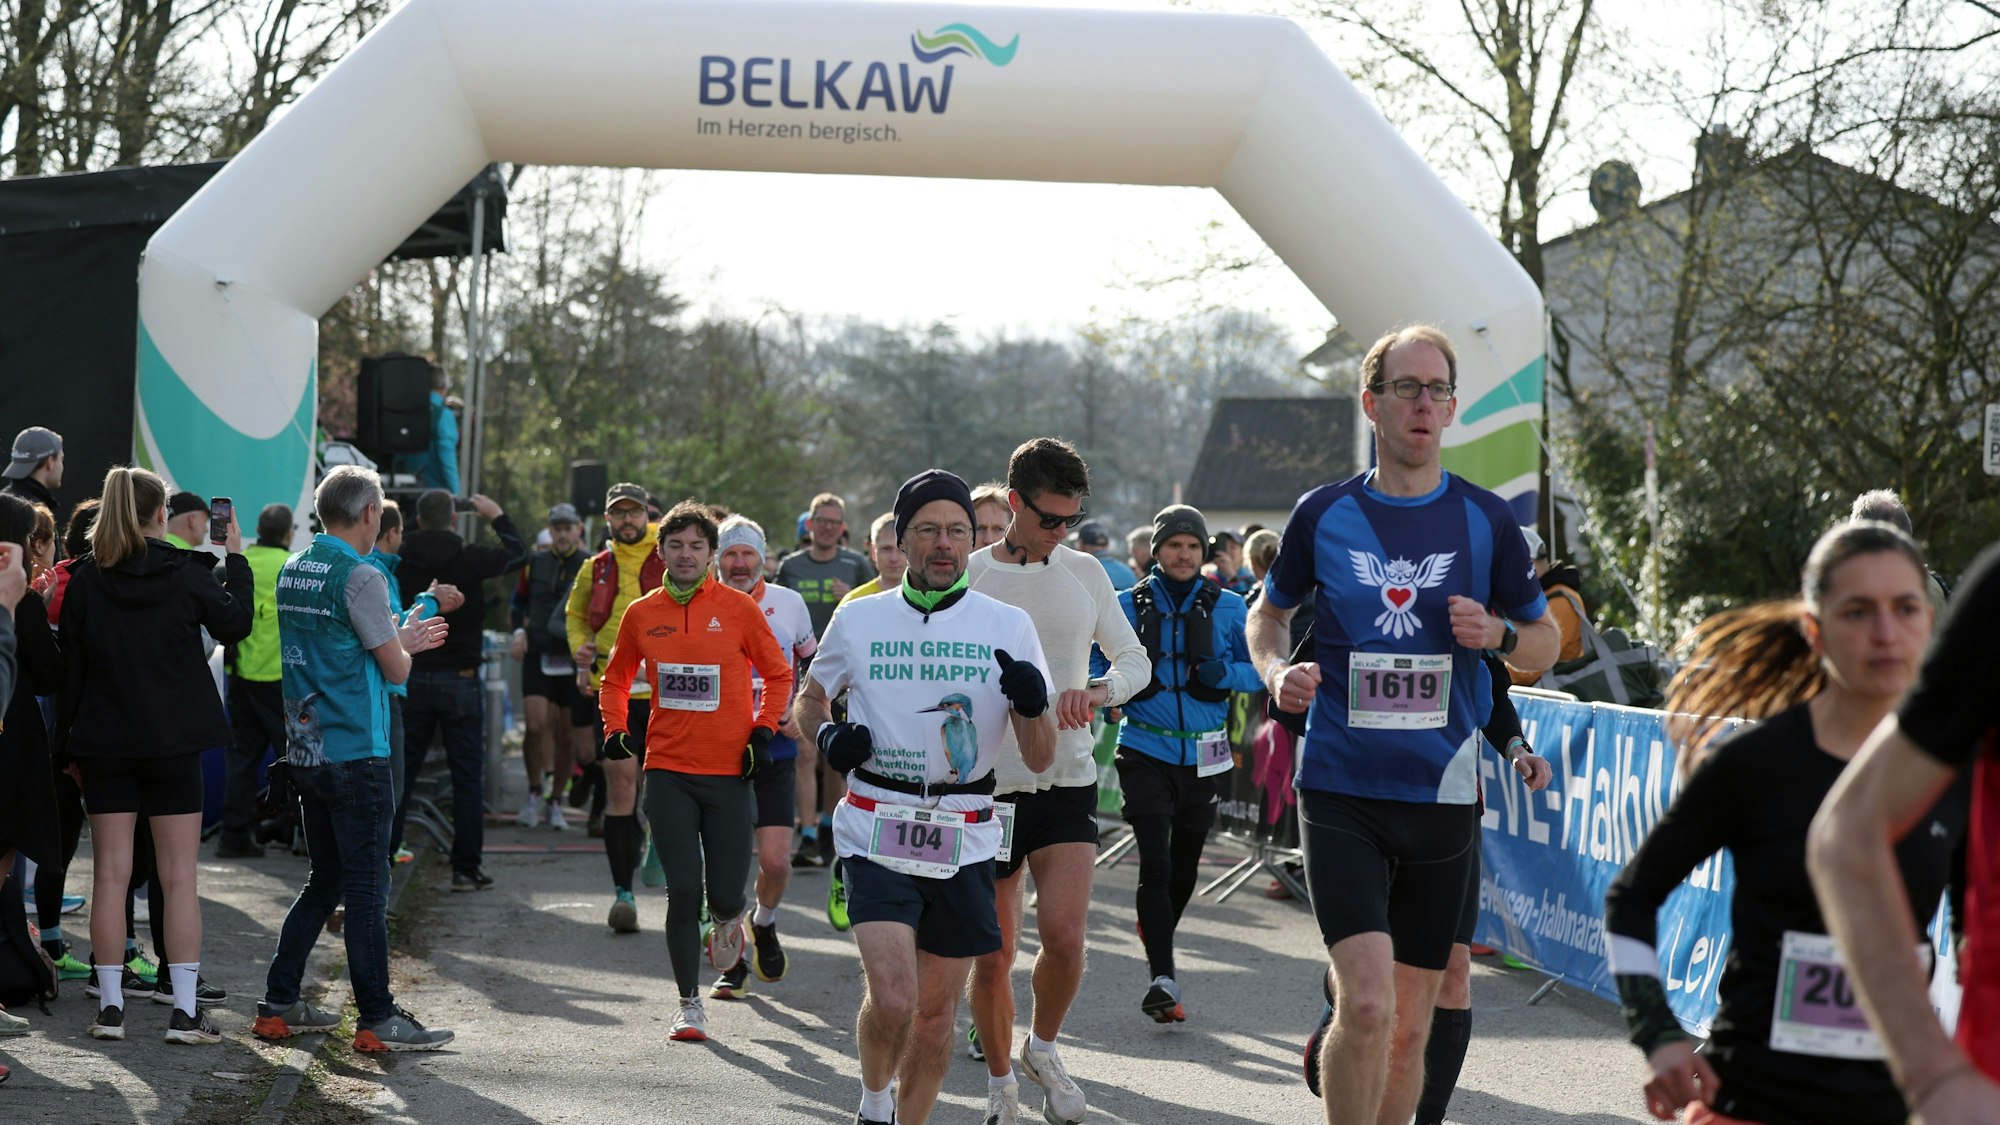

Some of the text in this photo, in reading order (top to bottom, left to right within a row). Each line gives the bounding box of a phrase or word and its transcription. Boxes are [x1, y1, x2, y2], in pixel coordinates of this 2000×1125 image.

[699, 55, 954, 114] BELKAW
[697, 117, 902, 145] Im Herzen bergisch.
[299, 560, 332, 574] GREEN
[293, 578, 326, 592] HAPPY
[870, 640, 992, 661] RUN GREEN
[666, 674, 710, 693] 2336
[869, 663, 991, 684] RUN HAPPY
[1365, 671, 1438, 700] 1619
[896, 822, 942, 851] 104
